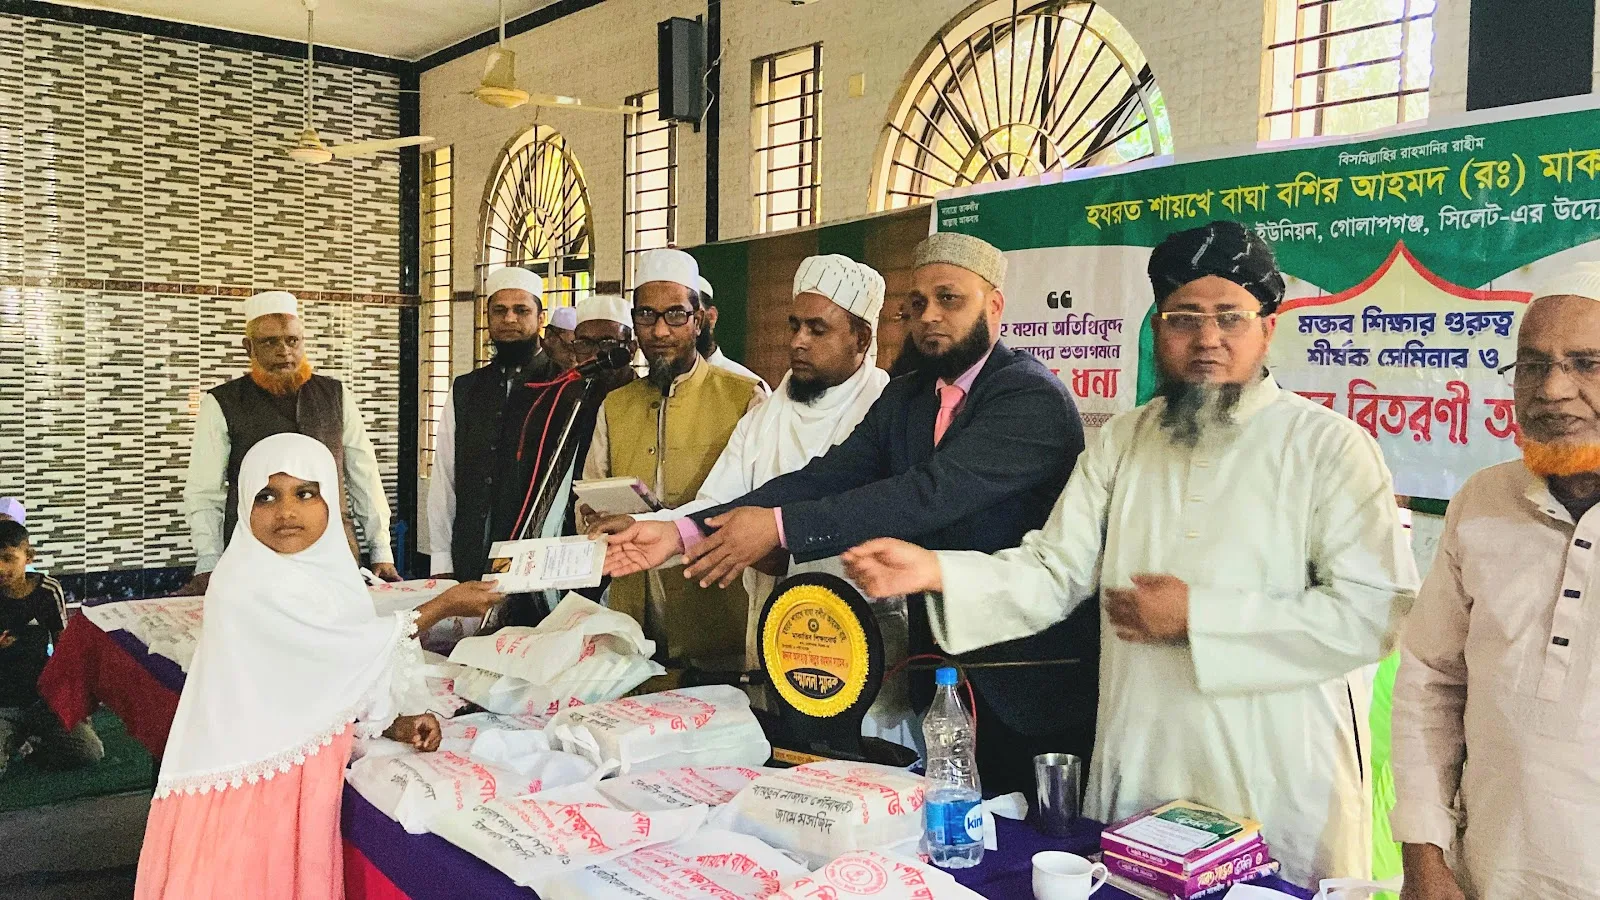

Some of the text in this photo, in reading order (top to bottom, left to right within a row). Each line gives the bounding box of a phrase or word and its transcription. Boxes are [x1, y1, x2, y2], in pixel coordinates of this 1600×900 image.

[1400, 140, 1449, 159] রাহমানির
[1452, 135, 1485, 153] রাহীম
[1085, 200, 1144, 230] হযরত
[1148, 188, 1215, 221] শায়খে
[1219, 182, 1270, 214] বাঘা
[1275, 171, 1343, 208] বশির
[1349, 166, 1451, 202] আহমদ
[1459, 152, 1526, 200] (রঃ)
[1254, 217, 1323, 245] ইউনিয়ন,
[1330, 213, 1430, 238] গোলাপগঞ্জ,
[1438, 201, 1547, 231] সিলেট-এর
[1012, 322, 1049, 336] মহান
[1052, 312, 1124, 341] অতিথিবৃন্দ
[1298, 305, 1515, 337] মক্তব শিক্ষার গুরুত্ব
[1059, 345, 1122, 360] শুভাগমনে
[1307, 338, 1500, 370] শীর্ষক সেমিনার ও
[1072, 368, 1122, 398] ধন্য
[1347, 378, 1471, 445] বিতরণী
[797, 811, 836, 835] মসজিদ
